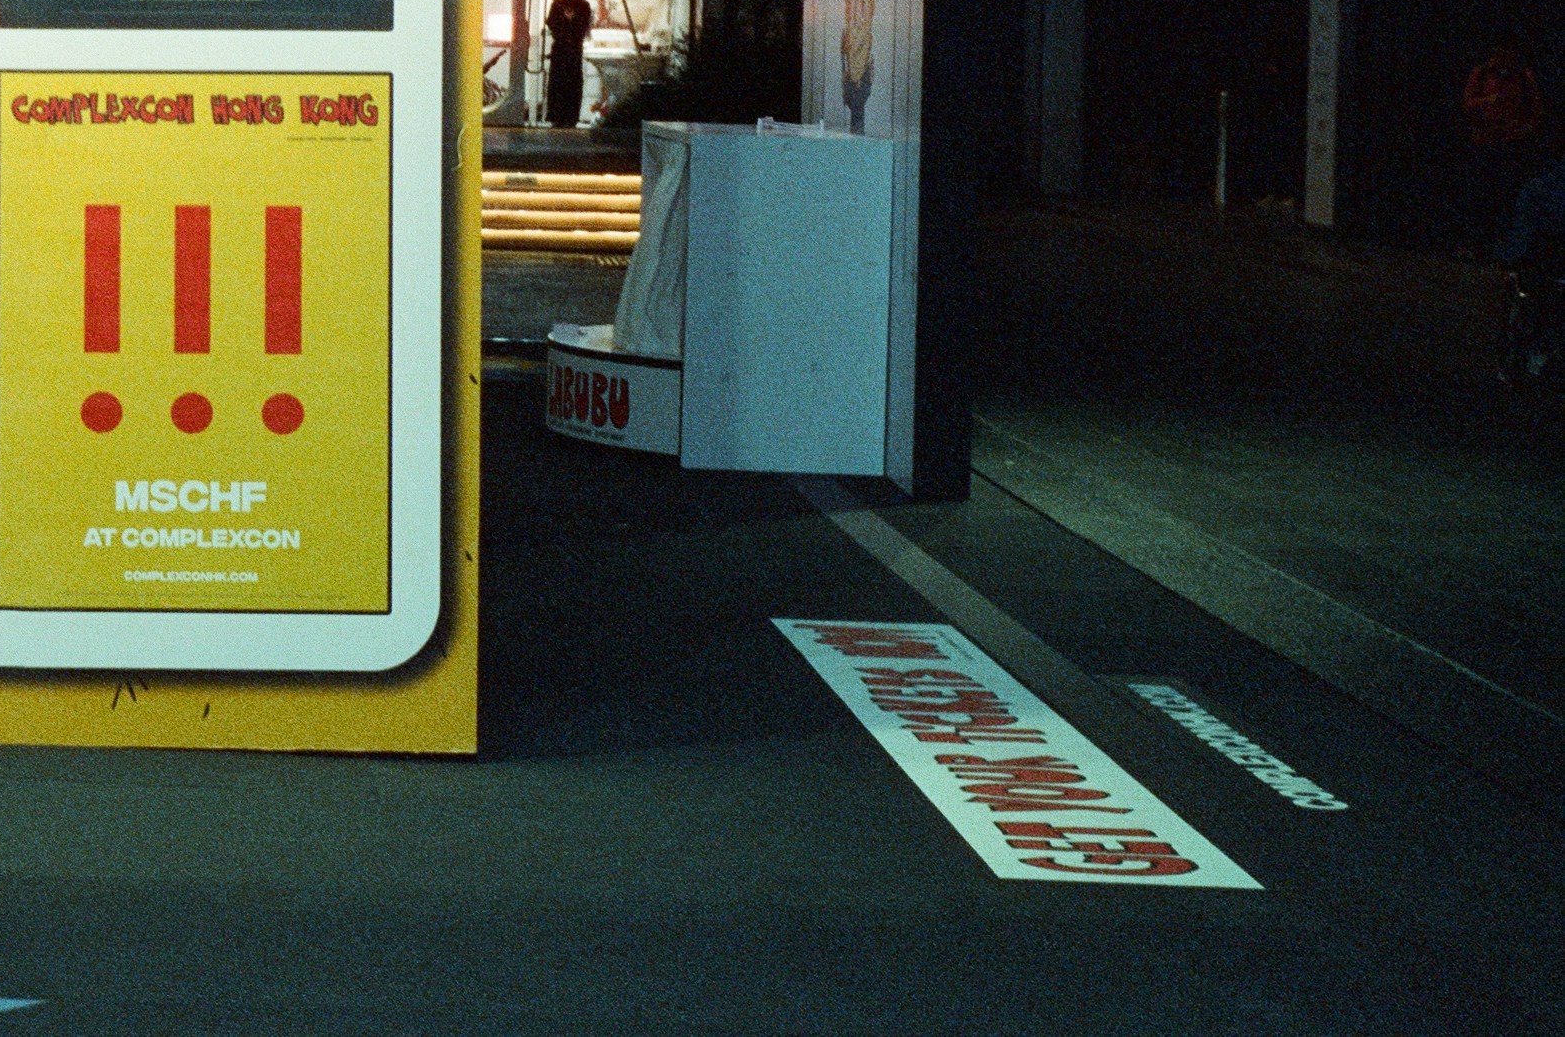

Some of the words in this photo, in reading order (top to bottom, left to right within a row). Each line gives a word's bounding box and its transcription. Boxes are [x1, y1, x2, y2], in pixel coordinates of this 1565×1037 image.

[11, 93, 194, 124] COMPLEXCON
[211, 95, 283, 124] HONG
[300, 94, 378, 126] KONG
[114, 479, 268, 513] MSCHF
[82, 527, 118, 547] AT
[121, 527, 301, 550] COMPLEXCON
[123, 570, 259, 583] COMPLEXCONHK.COM
[933, 753, 1135, 814] YOUR
[992, 820, 1200, 877] GET
